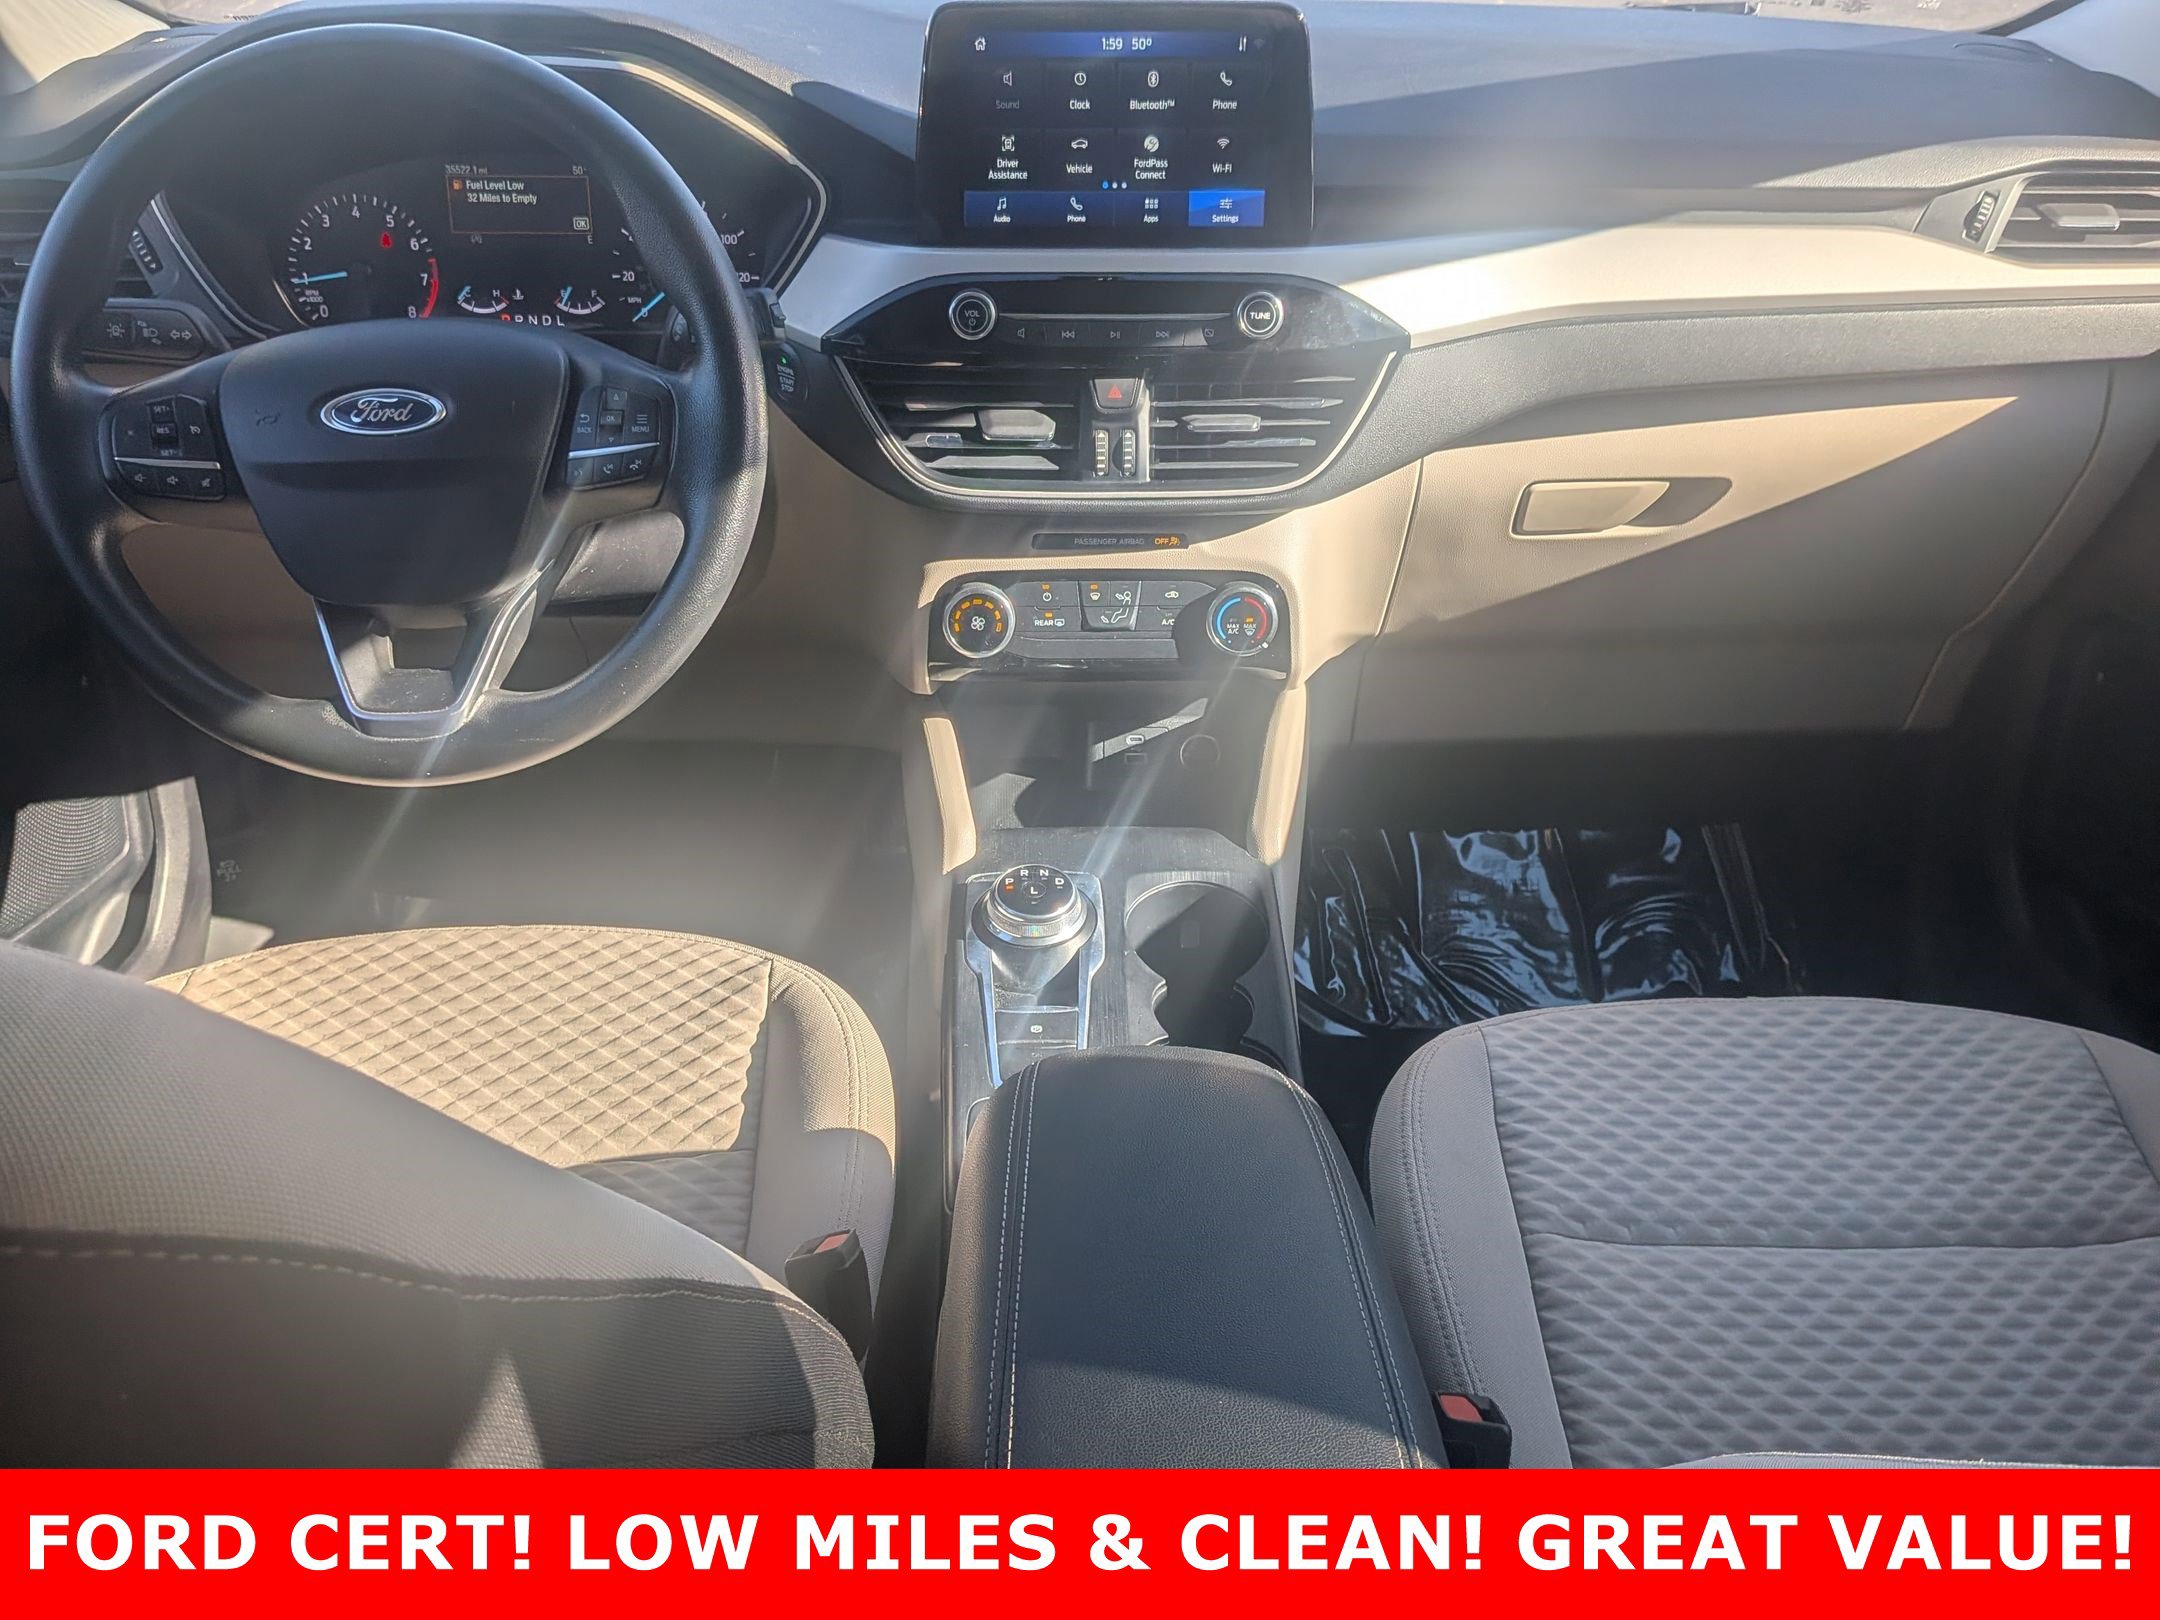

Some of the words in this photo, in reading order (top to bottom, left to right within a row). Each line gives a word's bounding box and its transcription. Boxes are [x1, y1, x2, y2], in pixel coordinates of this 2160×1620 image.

[1102, 37, 1123, 50] 1:59
[995, 99, 1020, 110] Sound
[1069, 99, 1090, 110] Clock
[1212, 99, 1238, 110] Phone
[996, 158, 1019, 168] Driver
[1066, 163, 1093, 174] Vehicle
[1134, 158, 1168, 169] FordPass
[1212, 163, 1232, 174] Wi-Fi
[988, 170, 1028, 180] Assistance
[1134, 169, 1166, 180] Connect
[466, 180, 483, 190] Fuel
[484, 180, 506, 190] Level
[507, 181, 525, 190] Low
[467, 193, 478, 203] 32
[479, 193, 501, 203] Miles
[502, 194, 511, 203] to
[512, 194, 538, 205] Empty
[352, 206, 361, 218] 4
[322, 214, 330, 228] 3
[386, 215, 394, 228] 5
[576, 220, 587, 228] OK
[993, 214, 1011, 224] Audio
[1066, 214, 1086, 224] Phone
[1143, 214, 1159, 225] Apps
[1212, 214, 1239, 224] Settings
[304, 238, 312, 250] 2
[410, 238, 419, 250] 6
[420, 273, 428, 286] 7
[622, 272, 635, 282] 20
[492, 289, 500, 297] H
[591, 290, 598, 298] F
[320, 305, 329, 318] 0
[408, 306, 417, 318] 8
[964, 310, 980, 318] VOL
[1250, 312, 1271, 320] TUNE
[528, 315, 538, 326] N
[542, 315, 552, 326] D
[556, 315, 566, 327] L
[350, 397, 414, 423] Ford
[1074, 538, 1117, 546] PASSENGER
[1118, 538, 1145, 546] AIRBAG
[1154, 538, 1169, 546] OFF
[1034, 619, 1054, 627] REAR
[1030, 886, 1038, 894] L
